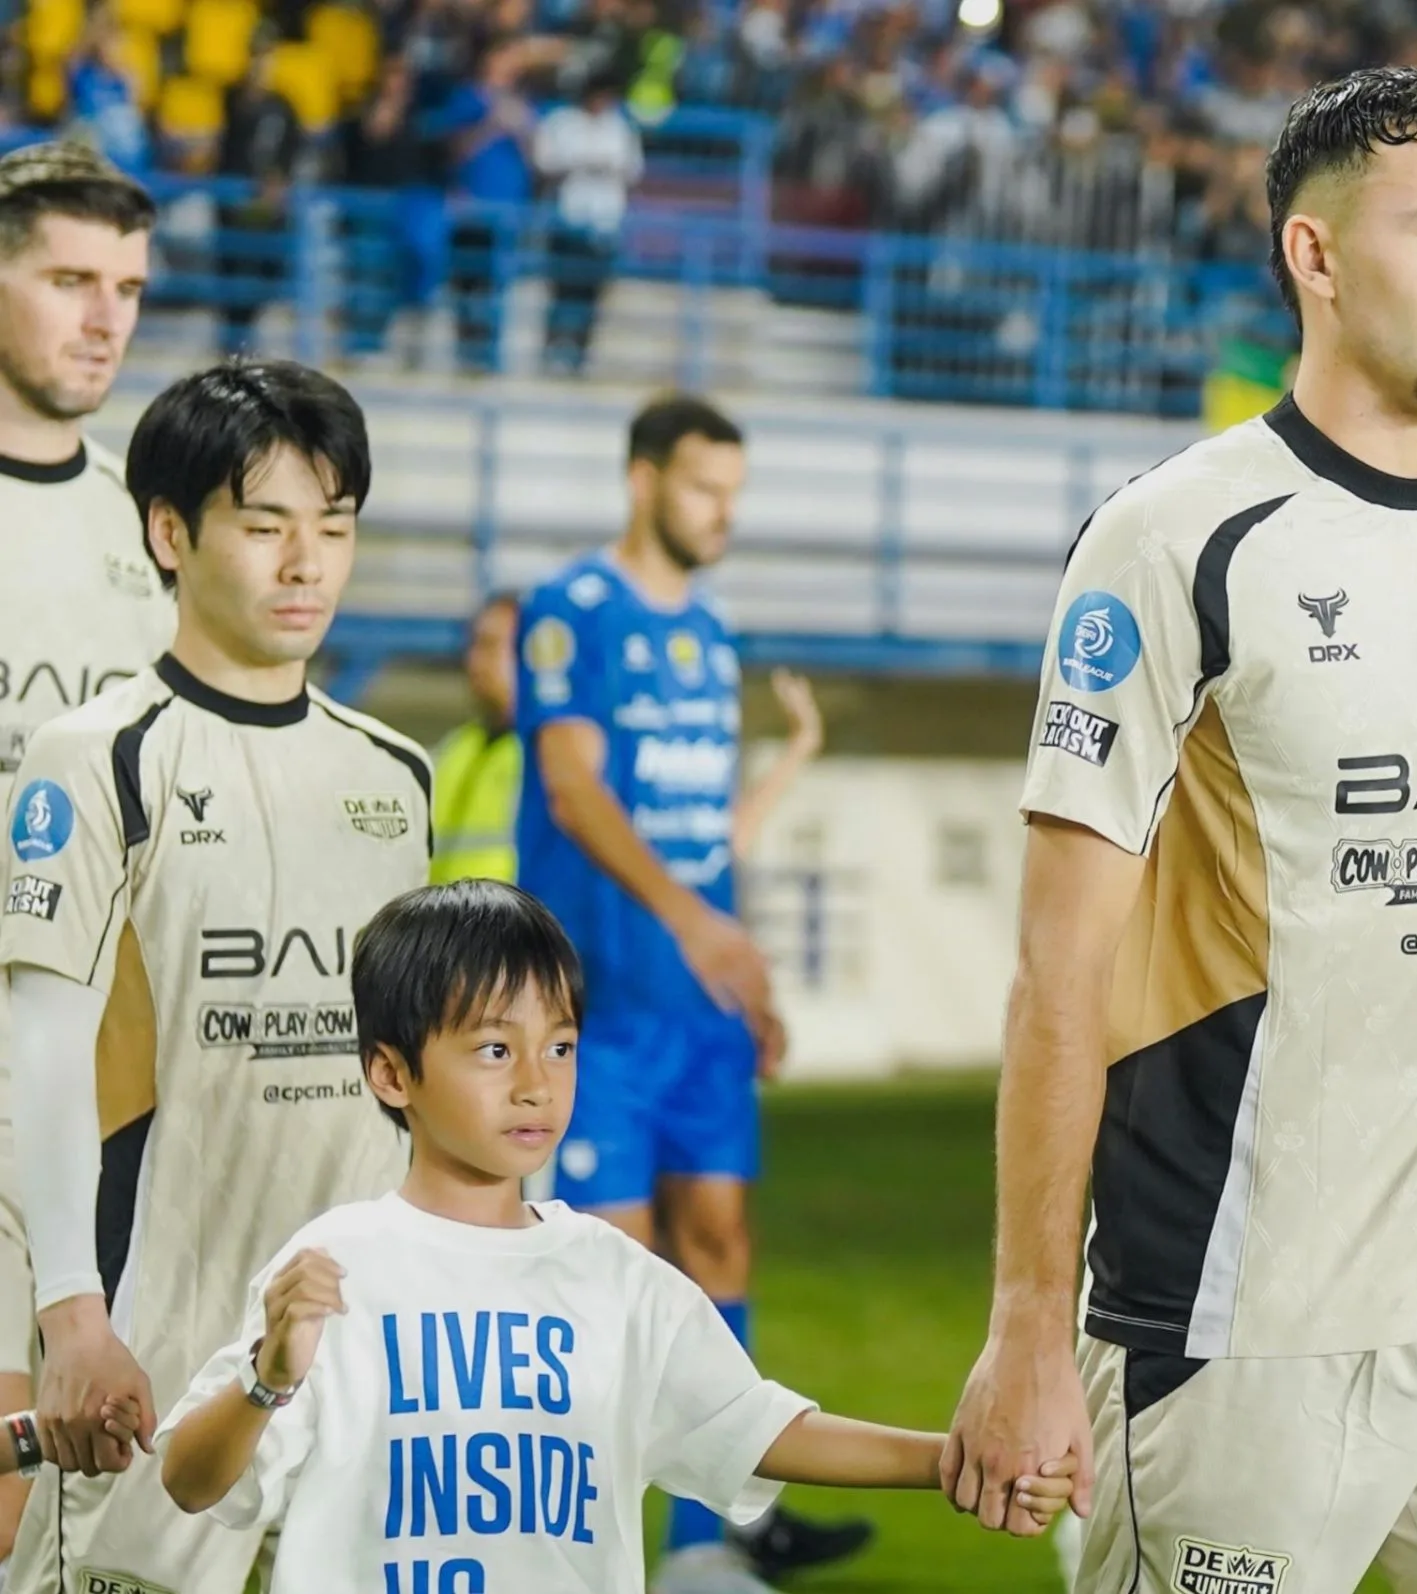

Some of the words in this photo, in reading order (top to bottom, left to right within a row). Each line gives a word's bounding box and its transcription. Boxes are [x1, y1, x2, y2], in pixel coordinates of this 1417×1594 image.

[1308, 643, 1361, 663] DRX
[1069, 709, 1109, 740] OUT
[180, 829, 227, 845] DRX
[1340, 847, 1390, 885] COW
[201, 926, 346, 978] BAI
[204, 1010, 251, 1042] COW
[264, 1011, 308, 1038] PLAY
[314, 1008, 353, 1035] COW
[264, 1078, 362, 1104] @cpcm.id
[382, 1311, 575, 1416] LIVES
[385, 1432, 598, 1545] INSIDE
[1184, 1545, 1276, 1580] DEWA
